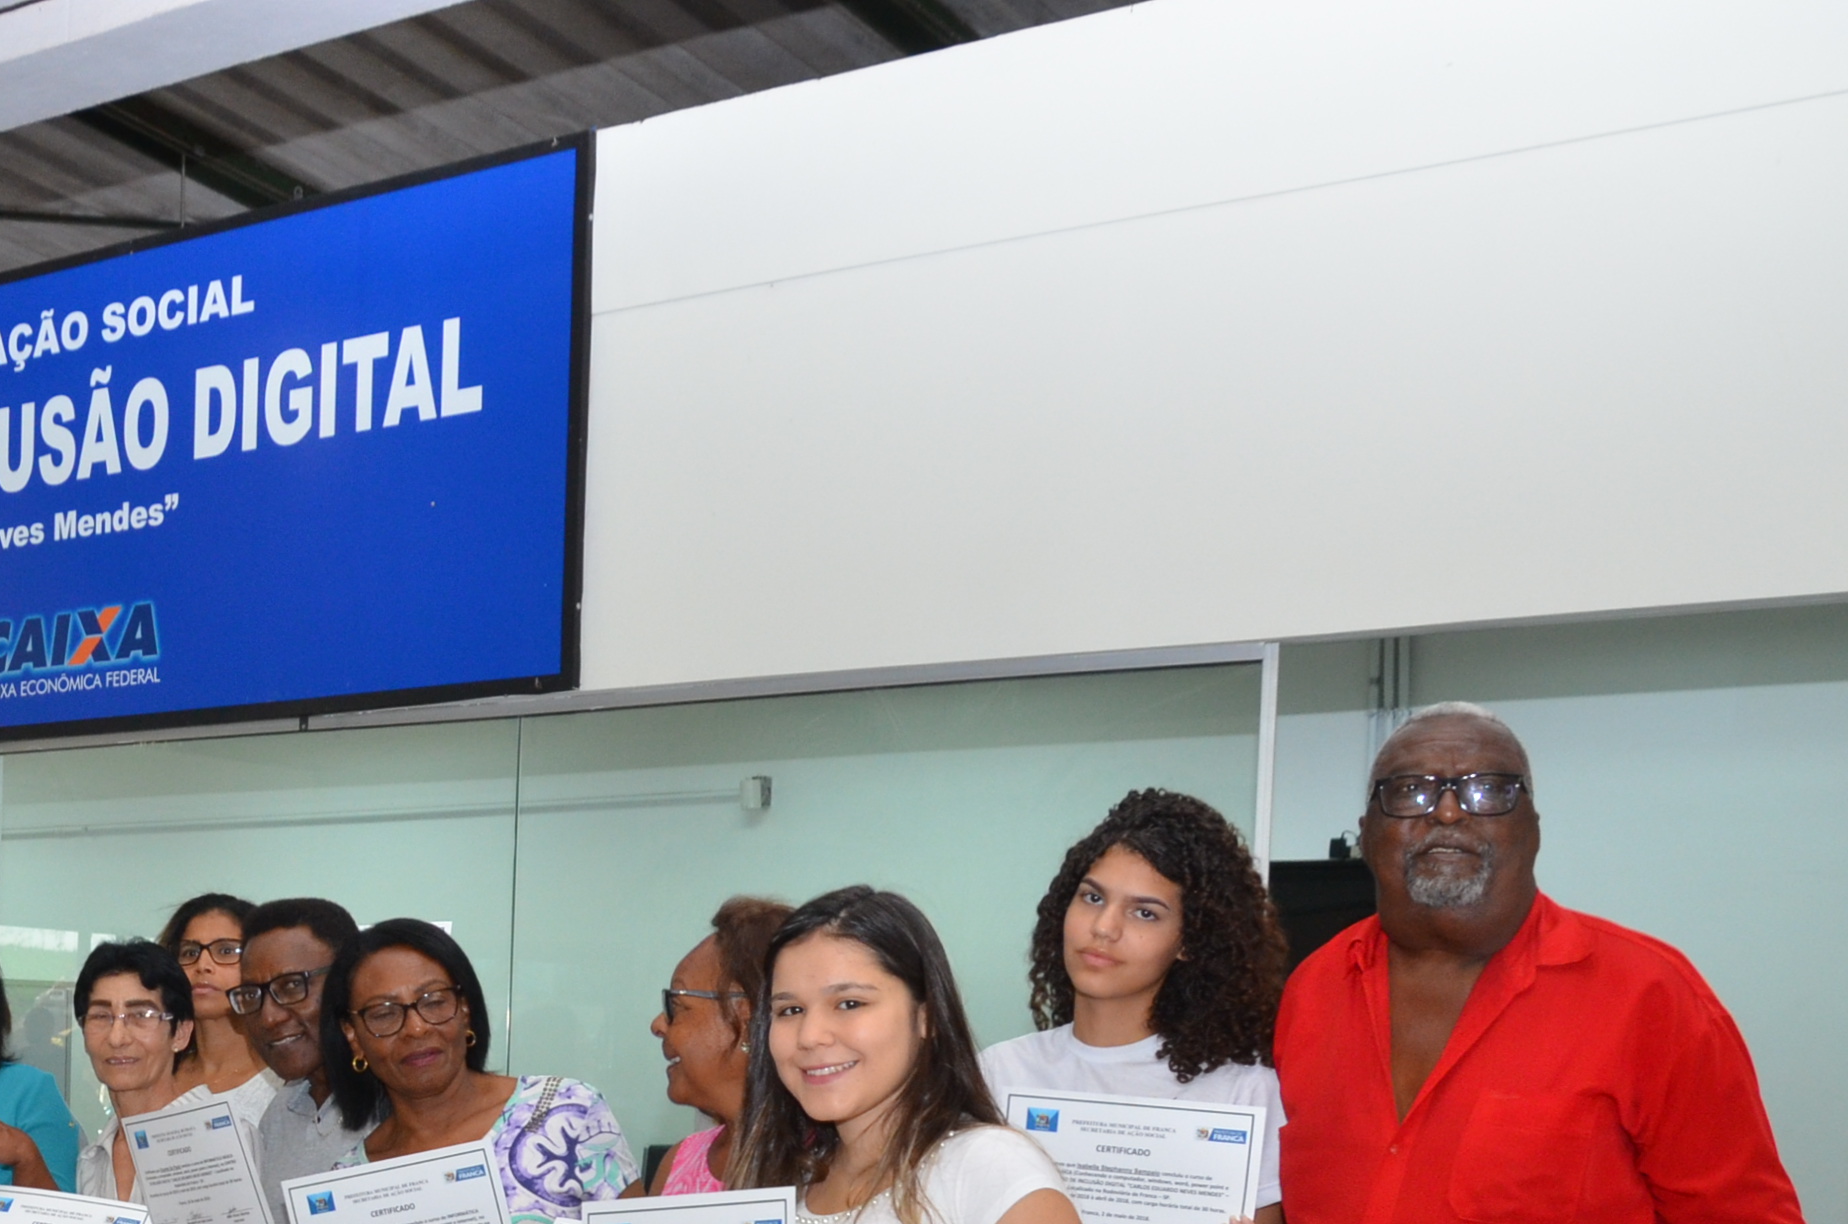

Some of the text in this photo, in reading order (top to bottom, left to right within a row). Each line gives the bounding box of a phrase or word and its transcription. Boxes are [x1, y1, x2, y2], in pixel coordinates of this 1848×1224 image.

[101, 275, 255, 344] SOCIAL
[194, 318, 483, 462] DIGITAL
[20, 673, 102, 696] ECONÔMICA
[106, 667, 161, 687] FEDERAL
[1213, 1133, 1244, 1142] FRANCA
[1095, 1144, 1150, 1156] CERTIFICADO
[458, 1169, 483, 1179] FRANCA
[370, 1202, 415, 1217] CERTIFICADO
